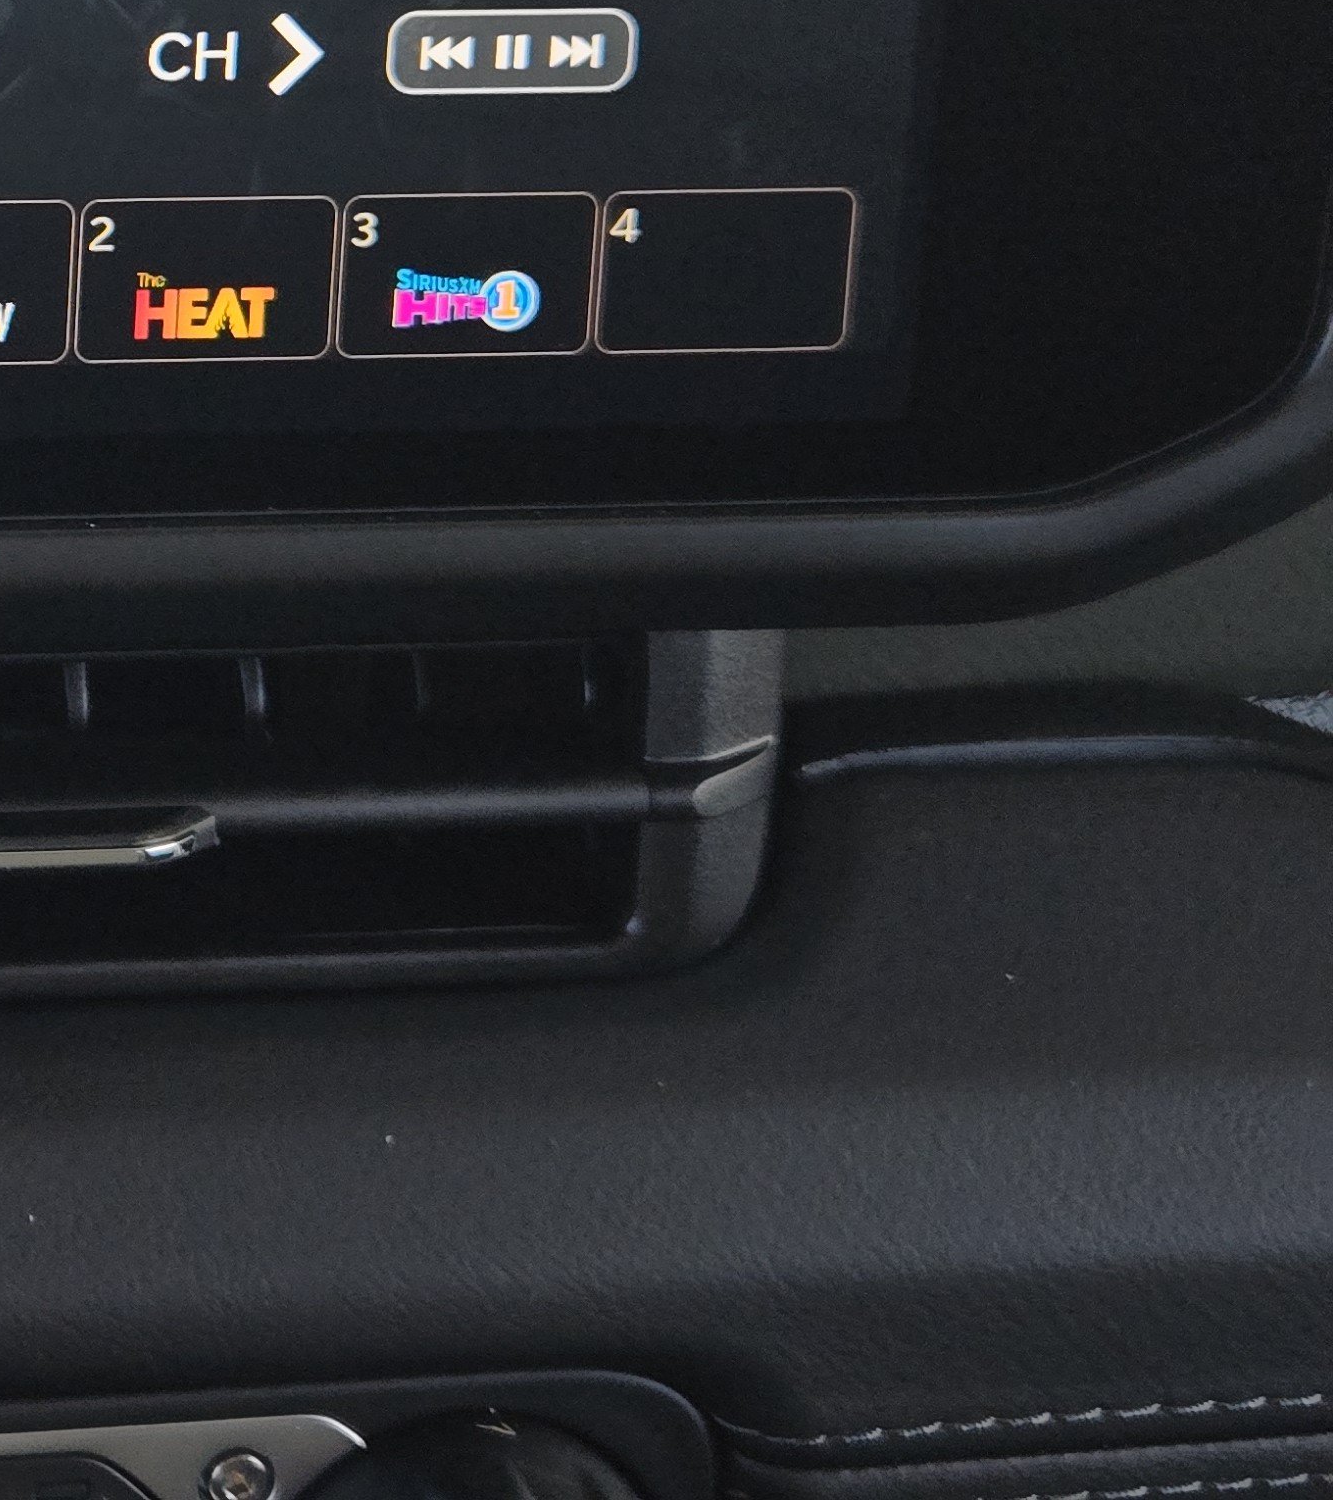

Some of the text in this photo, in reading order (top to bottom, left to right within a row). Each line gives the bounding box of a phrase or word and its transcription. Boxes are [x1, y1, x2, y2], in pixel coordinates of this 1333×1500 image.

[147, 29, 239, 82] CH
[88, 215, 116, 252] 2
[351, 211, 379, 248] 3
[608, 206, 641, 243] 4
[136, 271, 166, 288] The
[133, 286, 276, 340] HEAT
